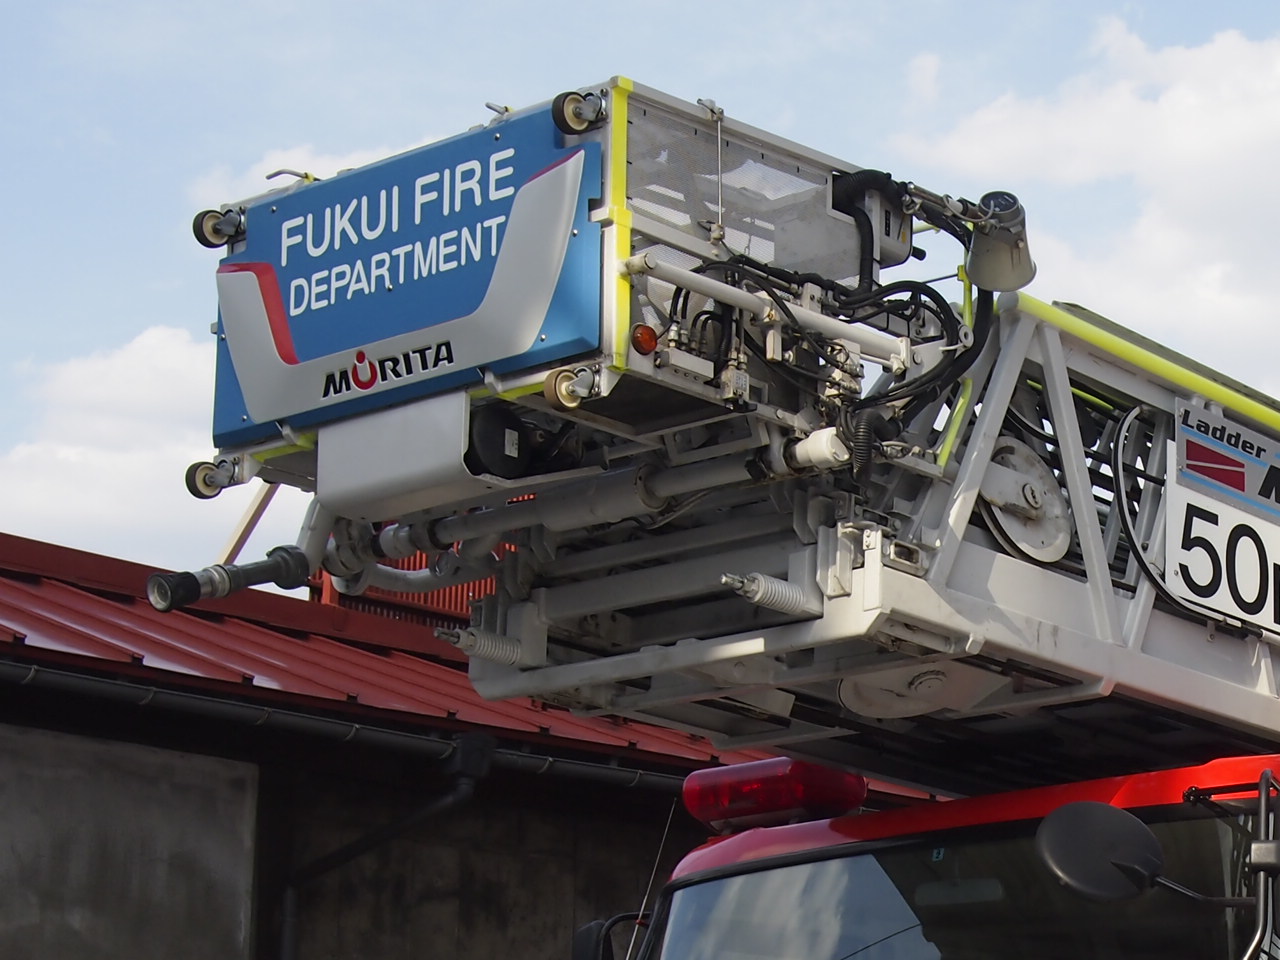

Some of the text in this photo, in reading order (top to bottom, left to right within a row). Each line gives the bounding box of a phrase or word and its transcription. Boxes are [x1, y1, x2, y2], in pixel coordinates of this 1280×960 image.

[281, 148, 515, 267] FUKUI FIRE
[290, 215, 506, 317] DEPARTMENT
[322, 340, 455, 398] MORITA
[1181, 409, 1266, 459] Ladder
